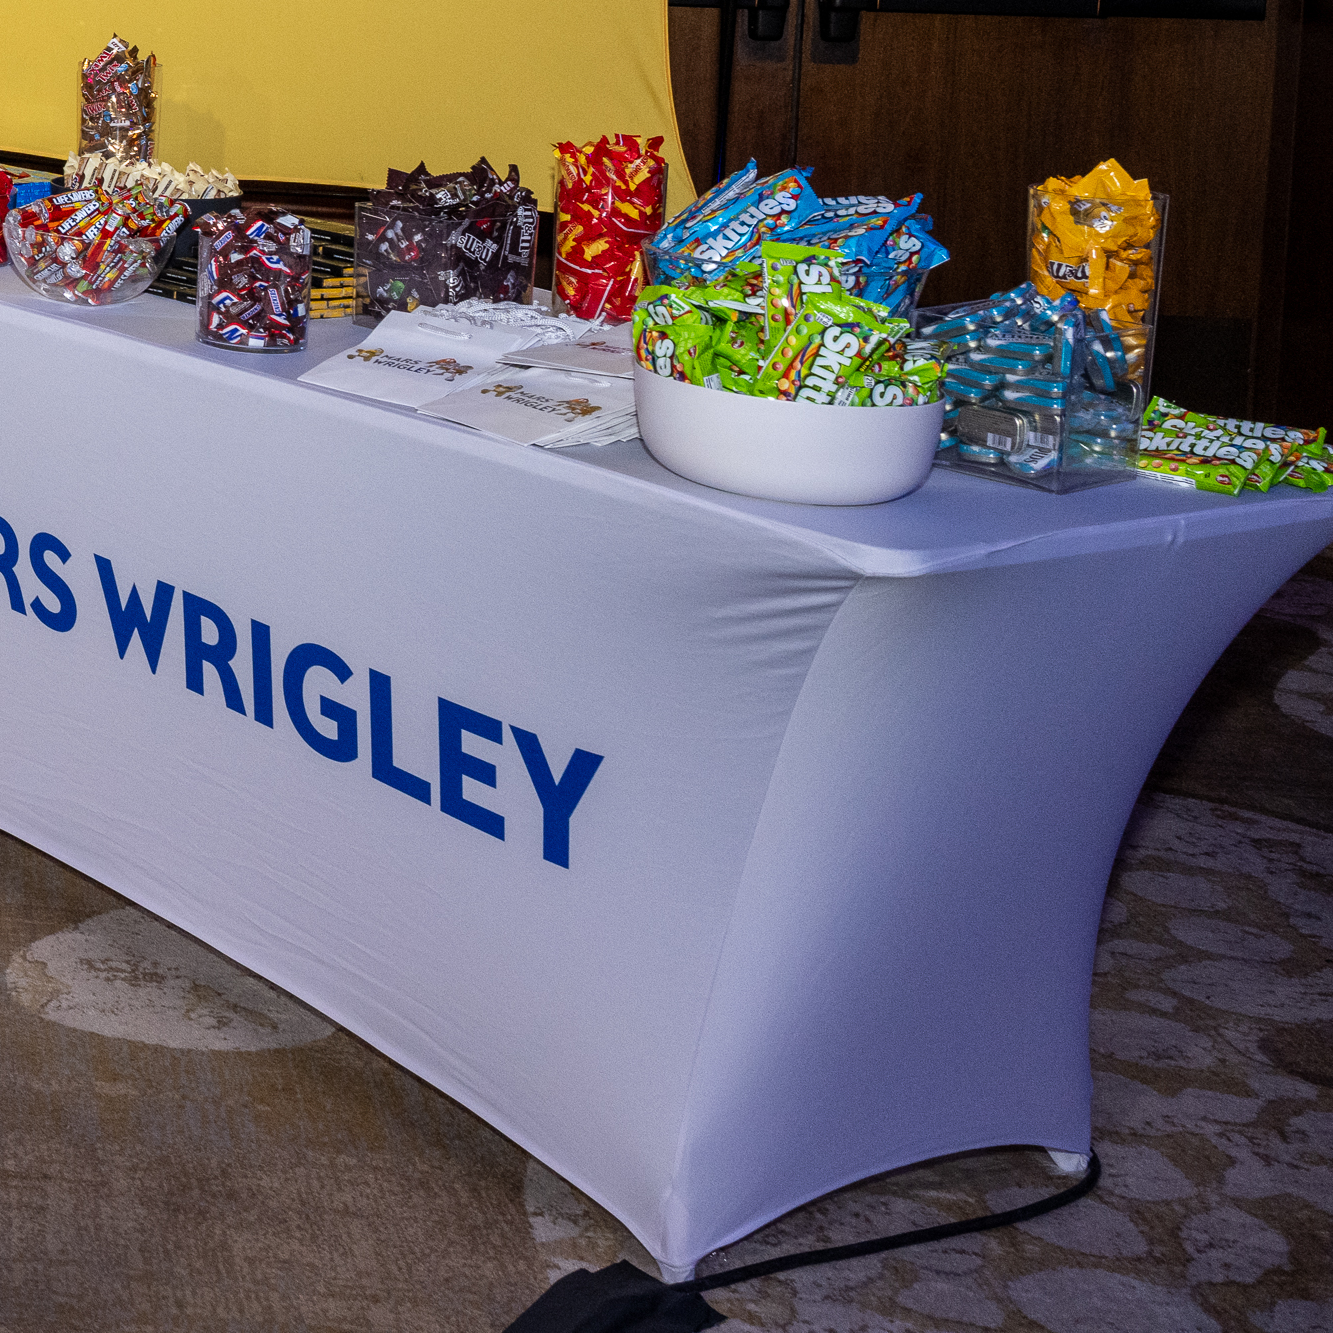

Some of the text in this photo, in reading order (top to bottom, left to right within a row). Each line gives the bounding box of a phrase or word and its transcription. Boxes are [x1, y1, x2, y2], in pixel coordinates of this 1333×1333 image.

[96, 61, 120, 82] TWIX
[84, 102, 106, 115] TWIX
[52, 189, 96, 206] LIFE SAVERS
[57, 201, 100, 234] LIFE SAVERS
[694, 191, 797, 272] Skittles
[268, 288, 282, 315] SNICKERS
[373, 358, 434, 376] WRIGLEY
[381, 354, 422, 365] MARS
[795, 326, 860, 406] Skitt
[503, 394, 559, 415] WRIGLEY
[515, 390, 554, 403] MARS
[1139, 430, 1259, 470] Skittles
[93, 553, 605, 870] WRIGLEY
